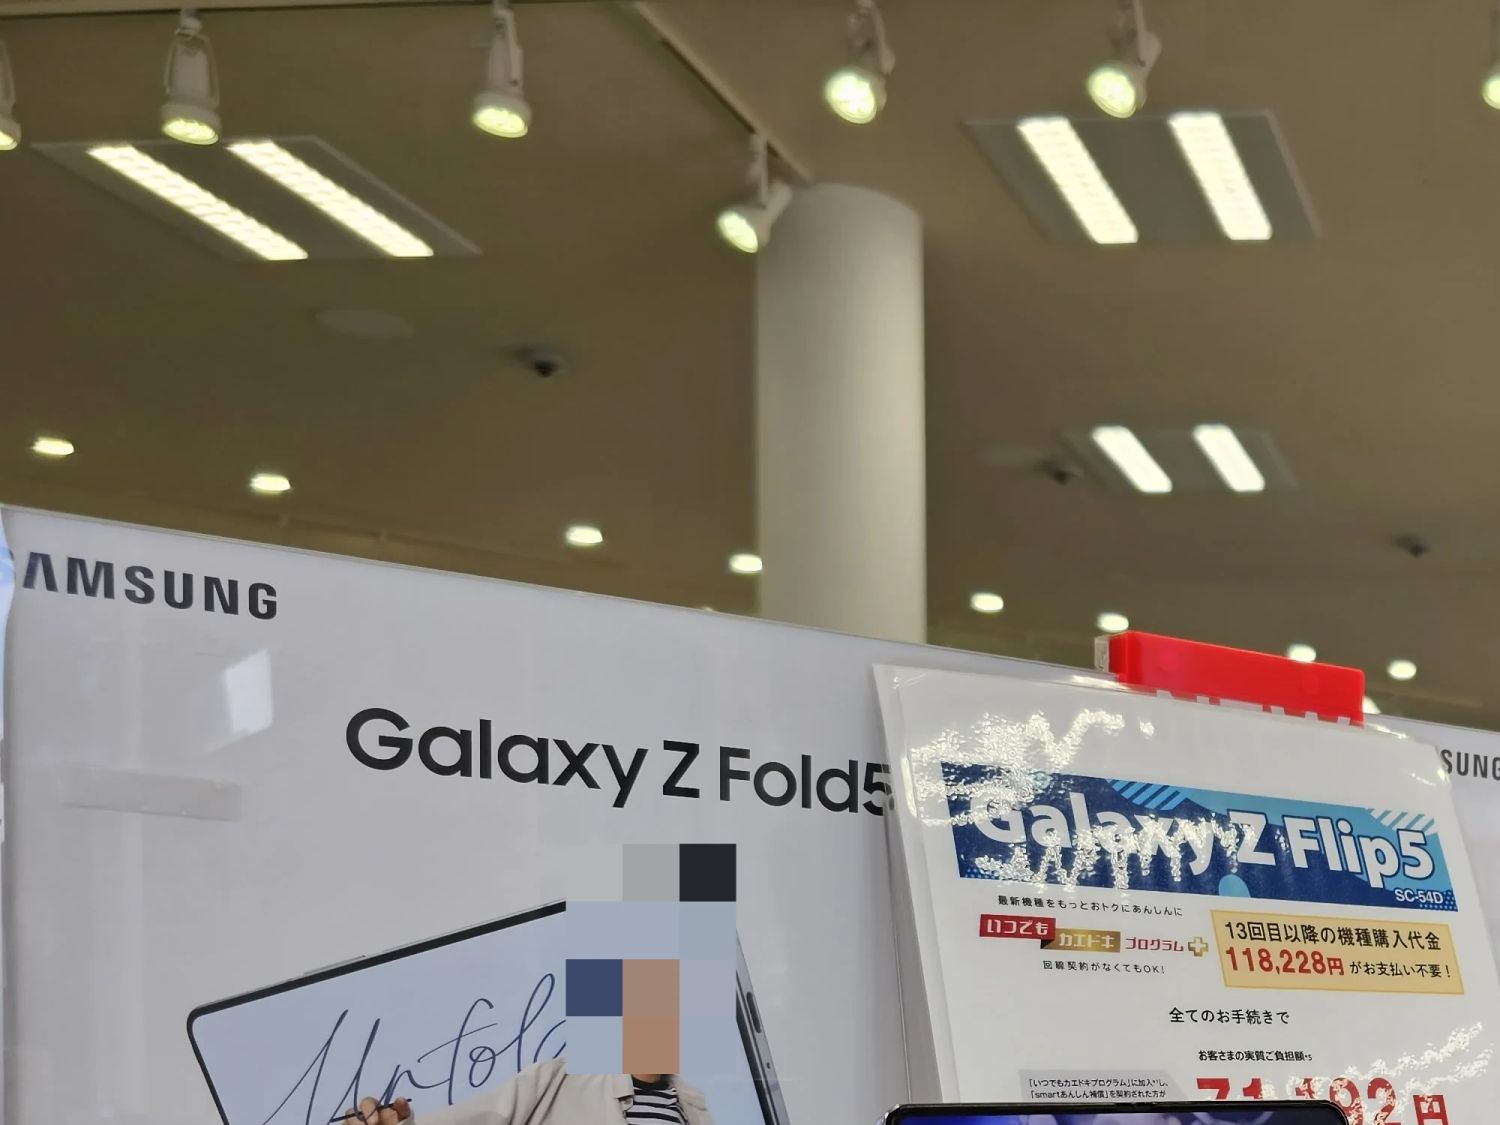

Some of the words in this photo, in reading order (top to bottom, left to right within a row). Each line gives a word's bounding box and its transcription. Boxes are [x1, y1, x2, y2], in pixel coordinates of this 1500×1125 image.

[23, 551, 278, 620] AMSUNG
[346, 708, 648, 808] Galaxy
[662, 740, 701, 799] Z
[719, 746, 892, 816] Fold5
[974, 787, 1213, 877] Galaxy
[1227, 811, 1278, 866] Z
[1283, 815, 1435, 888] Flip5
[998, 895, 1183, 917] 最新機種をもっとおトクにあんしんに
[1395, 889, 1444, 904] SC-54D
[987, 919, 1049, 935] いつでも
[1059, 932, 1115, 949] カエドキ
[1125, 936, 1184, 952] プログラム
[1225, 921, 1441, 950] 13回目以降の機種購入代金
[1043, 960, 1165, 974] 回線契約がなくてもOK!
[1226, 946, 1345, 976] 118,228円
[1349, 960, 1451, 979] がお支払い不要!
[1169, 1007, 1290, 1025] 全てのお手続きで
